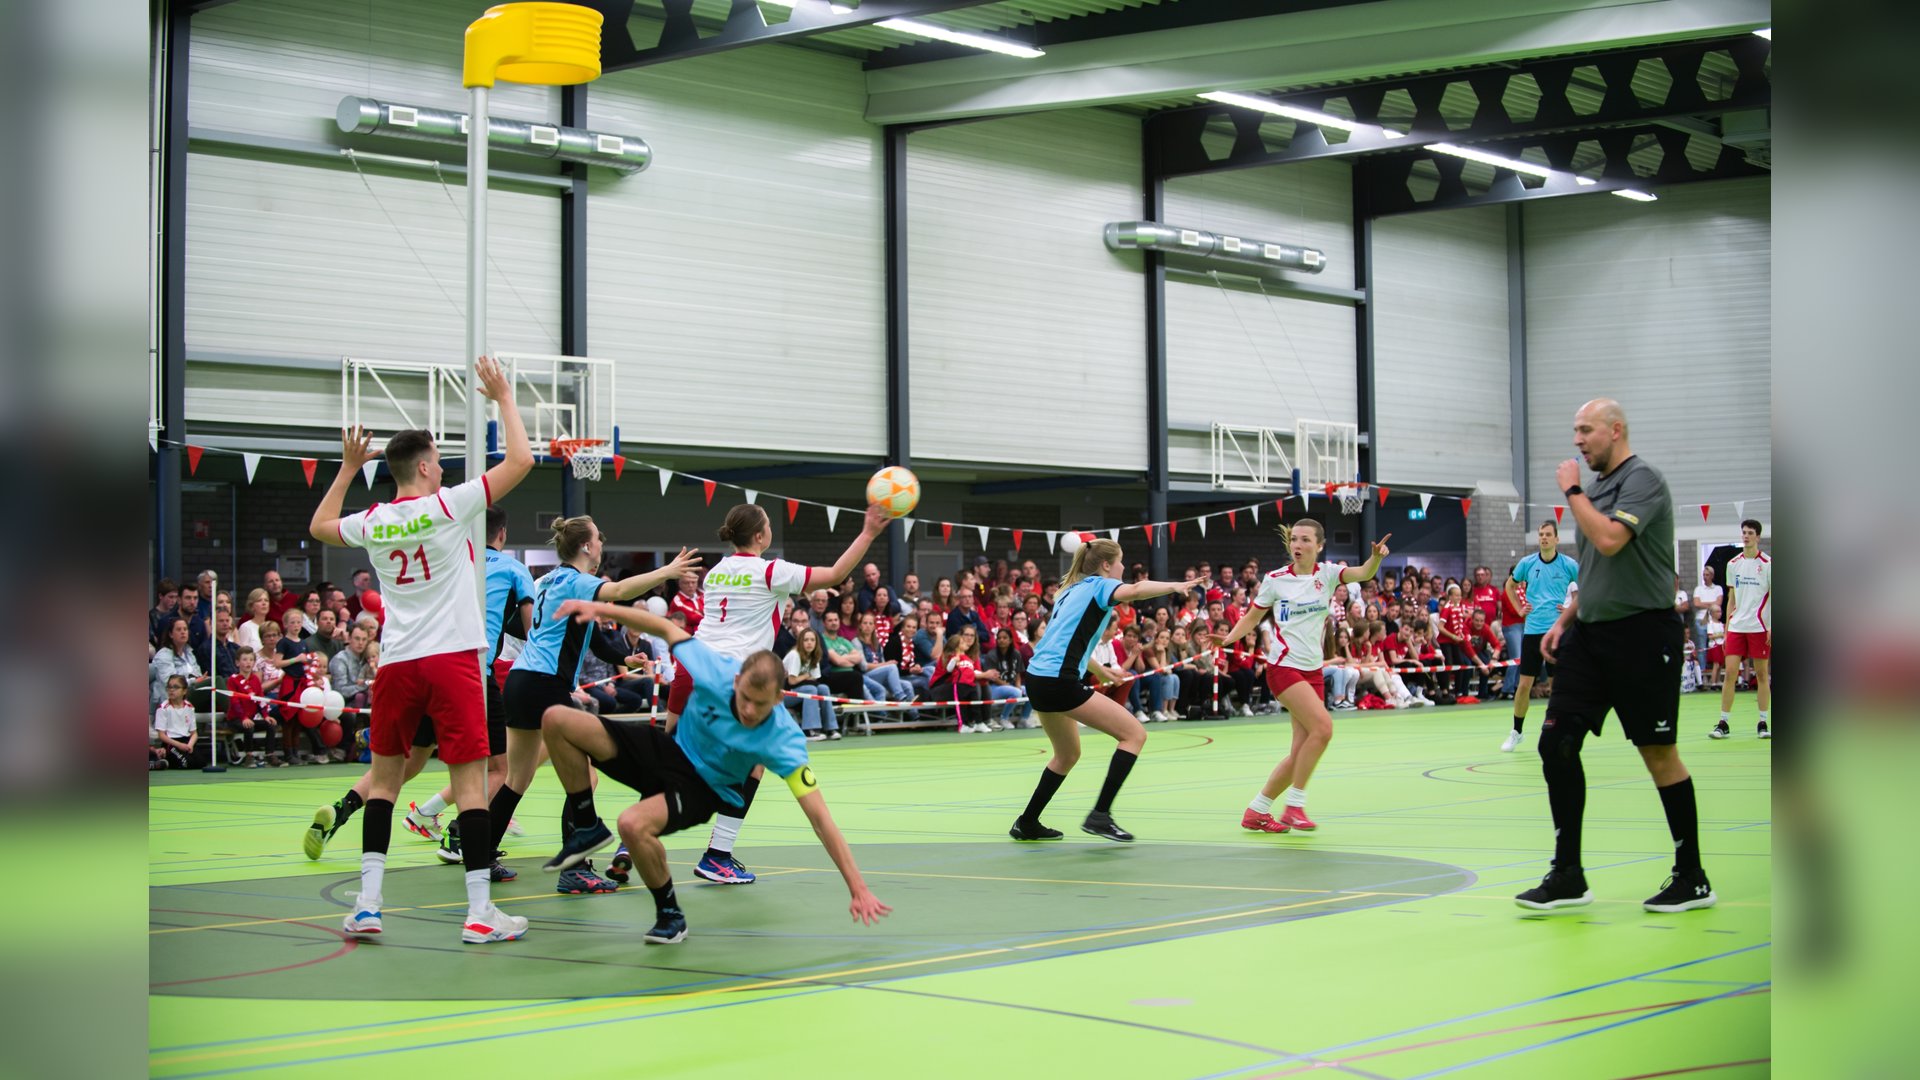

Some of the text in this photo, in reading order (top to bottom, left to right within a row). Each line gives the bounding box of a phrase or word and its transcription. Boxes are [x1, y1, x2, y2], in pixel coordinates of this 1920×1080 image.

[386, 513, 433, 539] PLUS
[389, 544, 431, 585] 21
[1535, 569, 1541, 579] 7
[715, 573, 753, 587] PLUS
[533, 589, 547, 630] 3
[719, 597, 728, 623] 1
[801, 766, 817, 788] C
